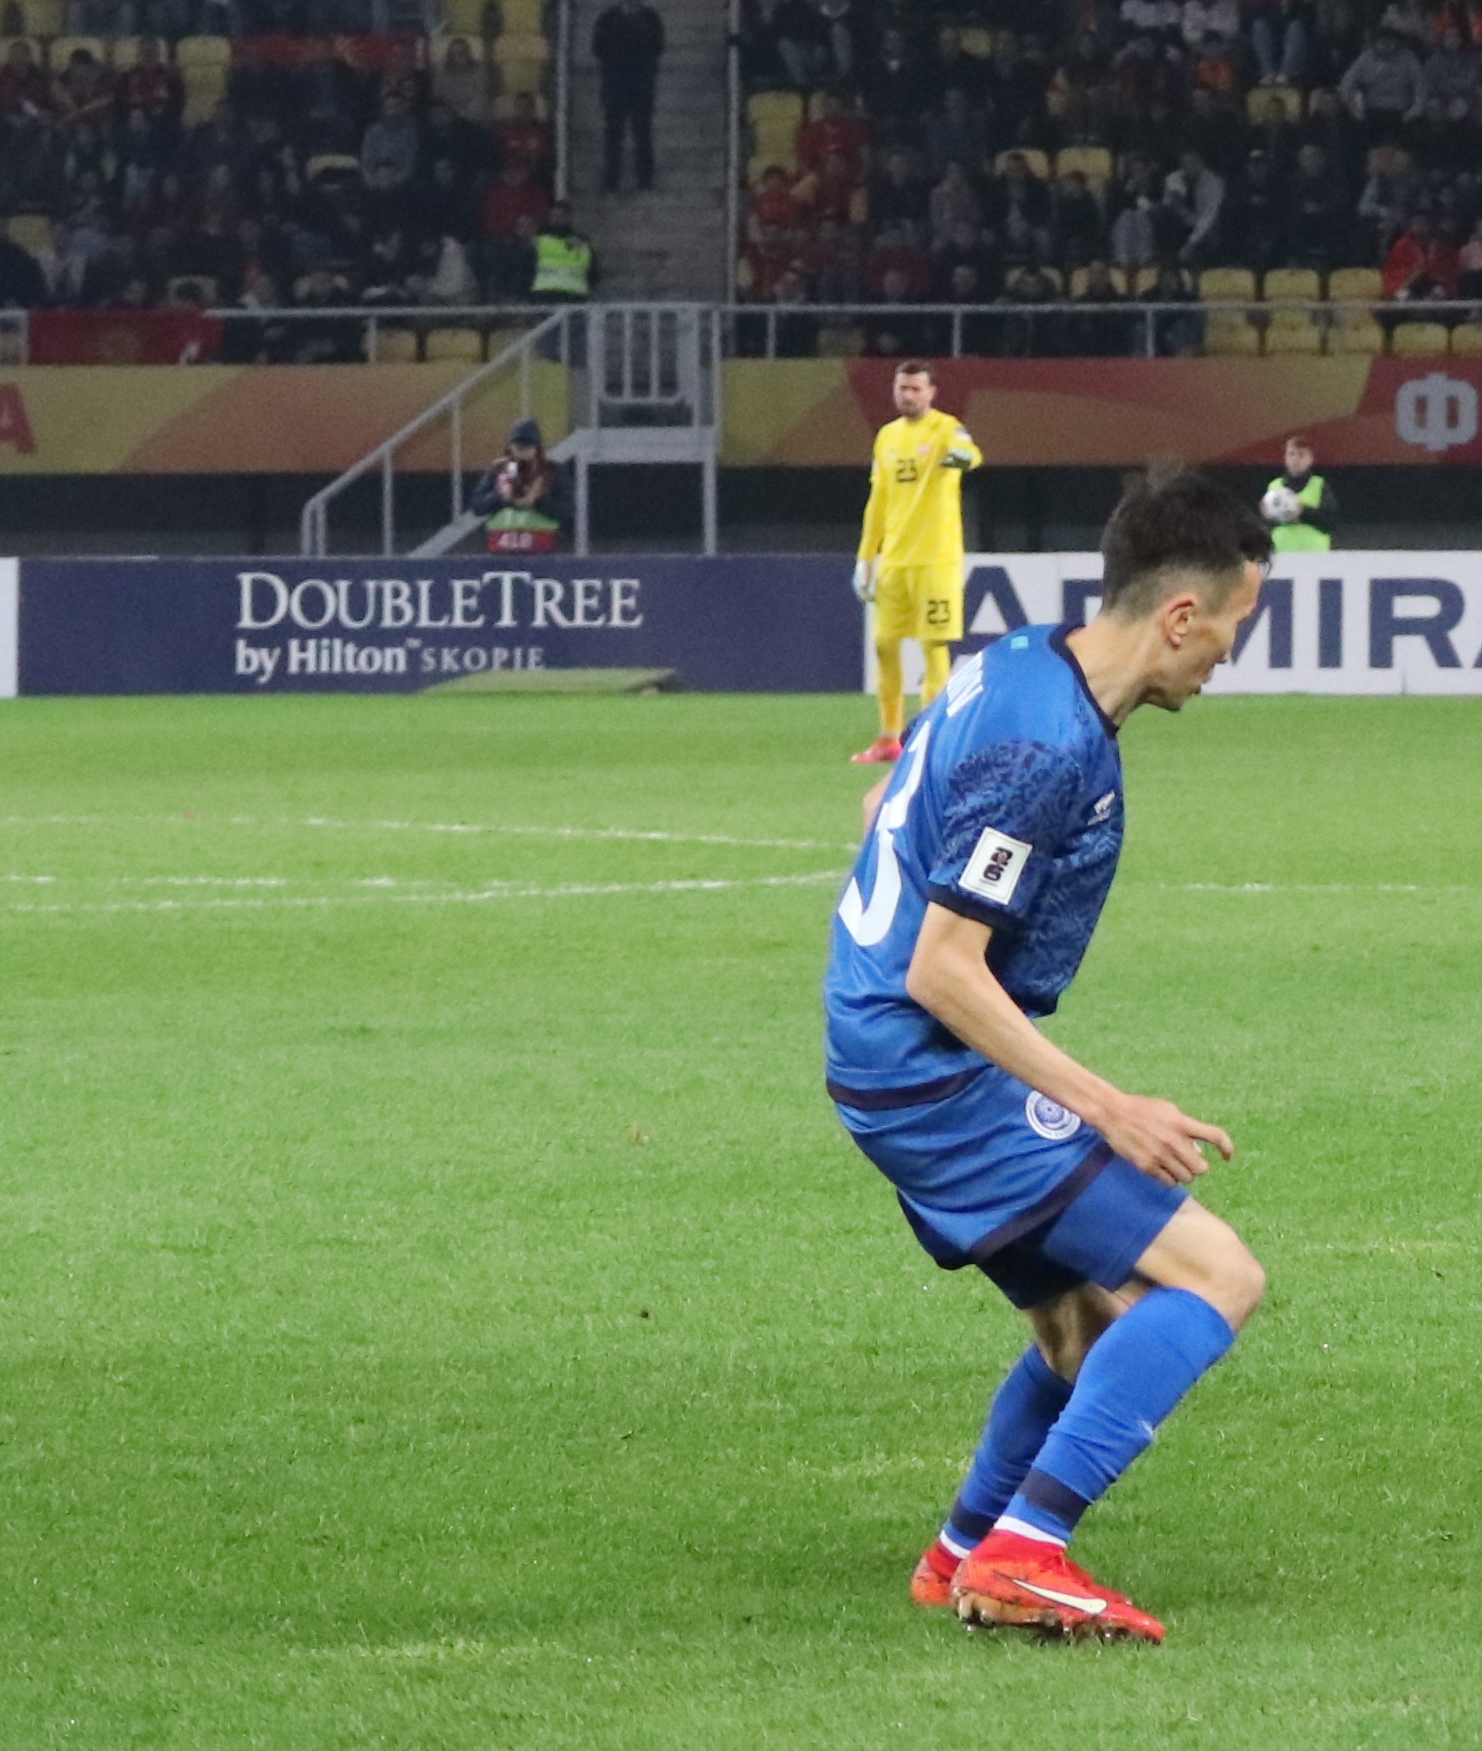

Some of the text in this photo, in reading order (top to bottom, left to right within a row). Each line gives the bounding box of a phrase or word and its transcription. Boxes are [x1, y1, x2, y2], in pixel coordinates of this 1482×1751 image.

[896, 459, 918, 482] 23
[926, 599, 950, 625] 23
[234, 639, 280, 684] by
